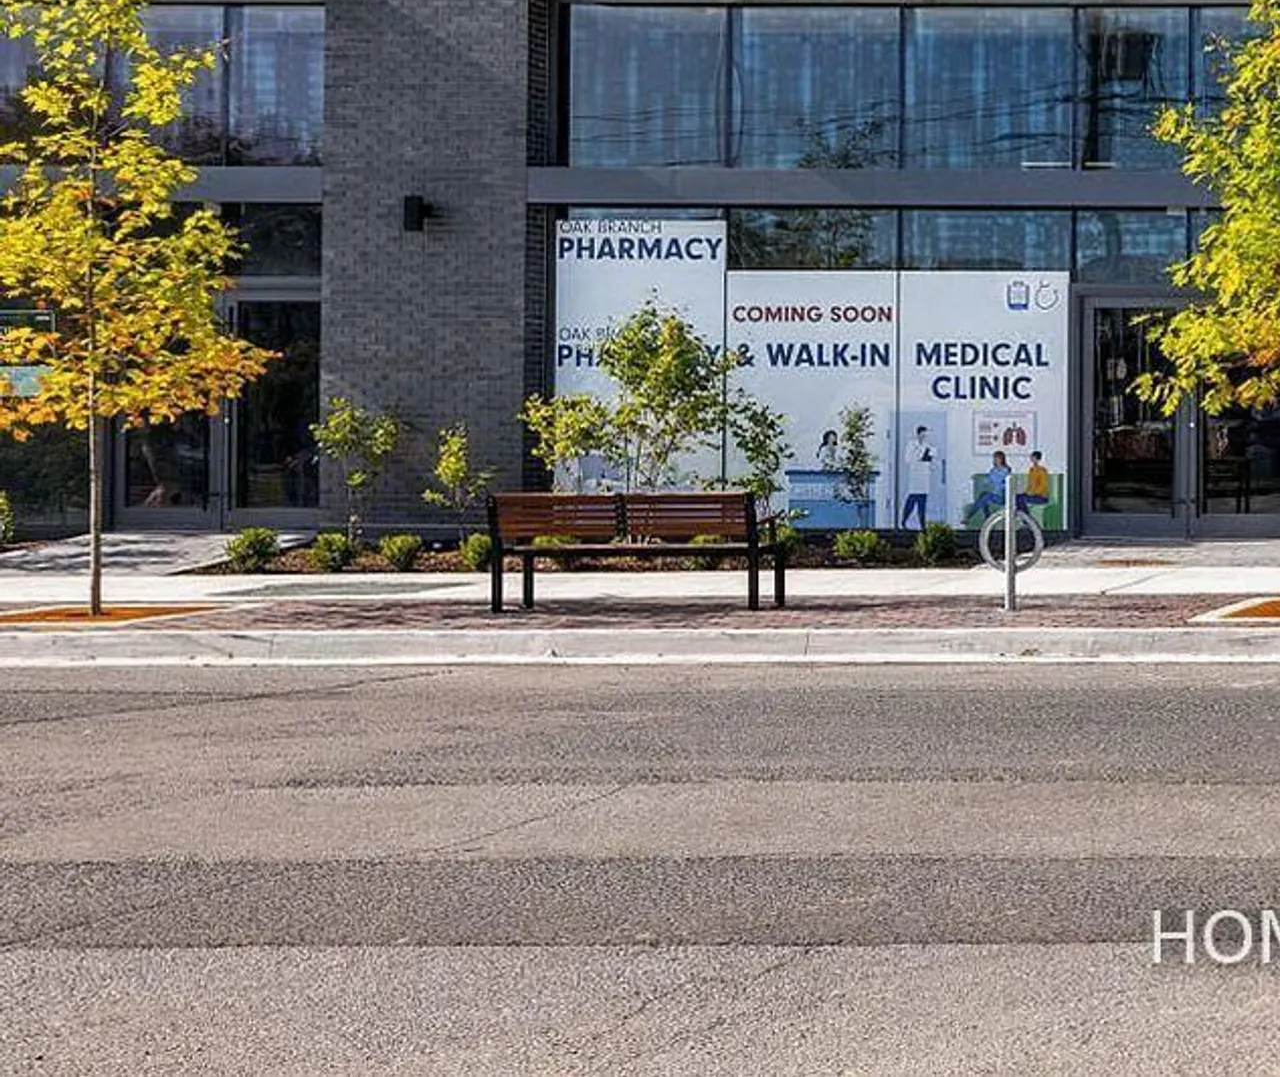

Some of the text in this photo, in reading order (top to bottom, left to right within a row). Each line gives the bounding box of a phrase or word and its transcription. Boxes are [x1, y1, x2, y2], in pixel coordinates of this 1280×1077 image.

[560, 221, 662, 234] OAK BRANCH
[558, 237, 723, 260] PHARMACY
[733, 305, 892, 323] COMING SOON
[736, 343, 755, 367] &
[766, 342, 891, 367] WALK-IN
[915, 342, 1050, 367] MEDICAL
[931, 375, 1032, 400] CLINIC
